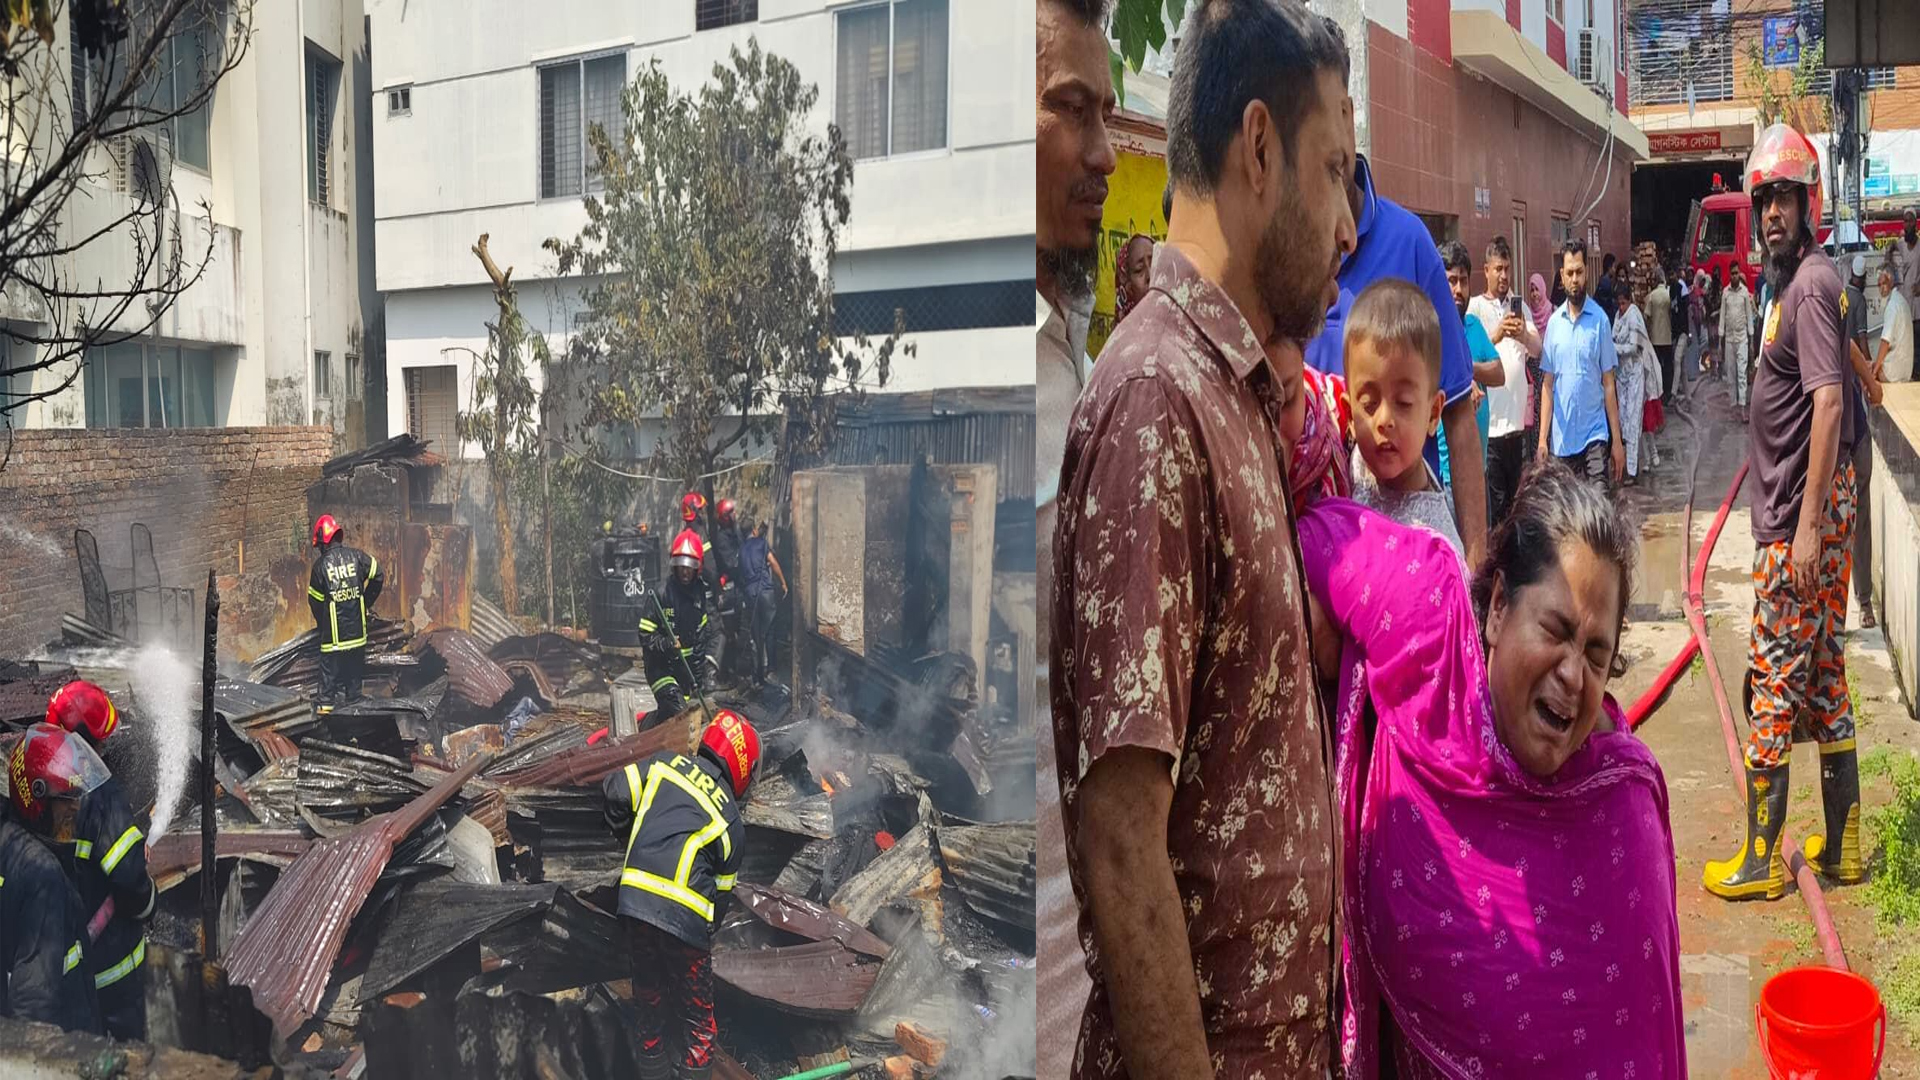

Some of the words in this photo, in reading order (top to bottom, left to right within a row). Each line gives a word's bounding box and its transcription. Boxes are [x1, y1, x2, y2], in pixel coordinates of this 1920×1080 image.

[327, 562, 357, 581] FIRE
[331, 586, 360, 602] RESCUE
[726, 722, 747, 756] FIRE
[11, 739, 26, 782] FIRE
[670, 754, 730, 811] FIRE
